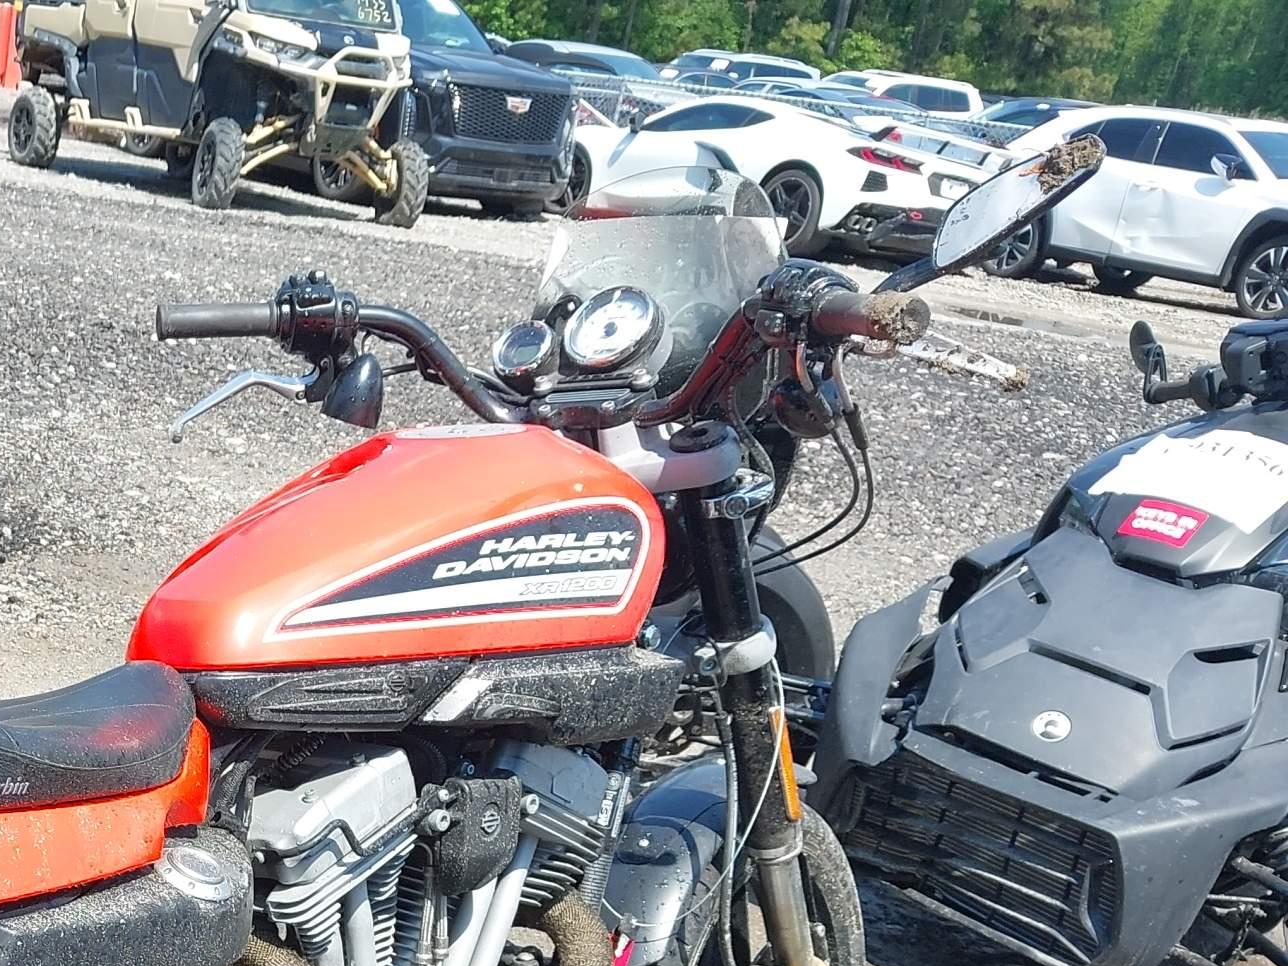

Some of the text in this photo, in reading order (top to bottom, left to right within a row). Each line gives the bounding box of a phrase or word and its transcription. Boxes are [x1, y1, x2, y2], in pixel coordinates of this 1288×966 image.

[358, 6, 392, 23] 6752
[479, 530, 636, 556] HARLEY-
[432, 547, 632, 580] DAVIDSON
[520, 576, 617, 596] XR1200
